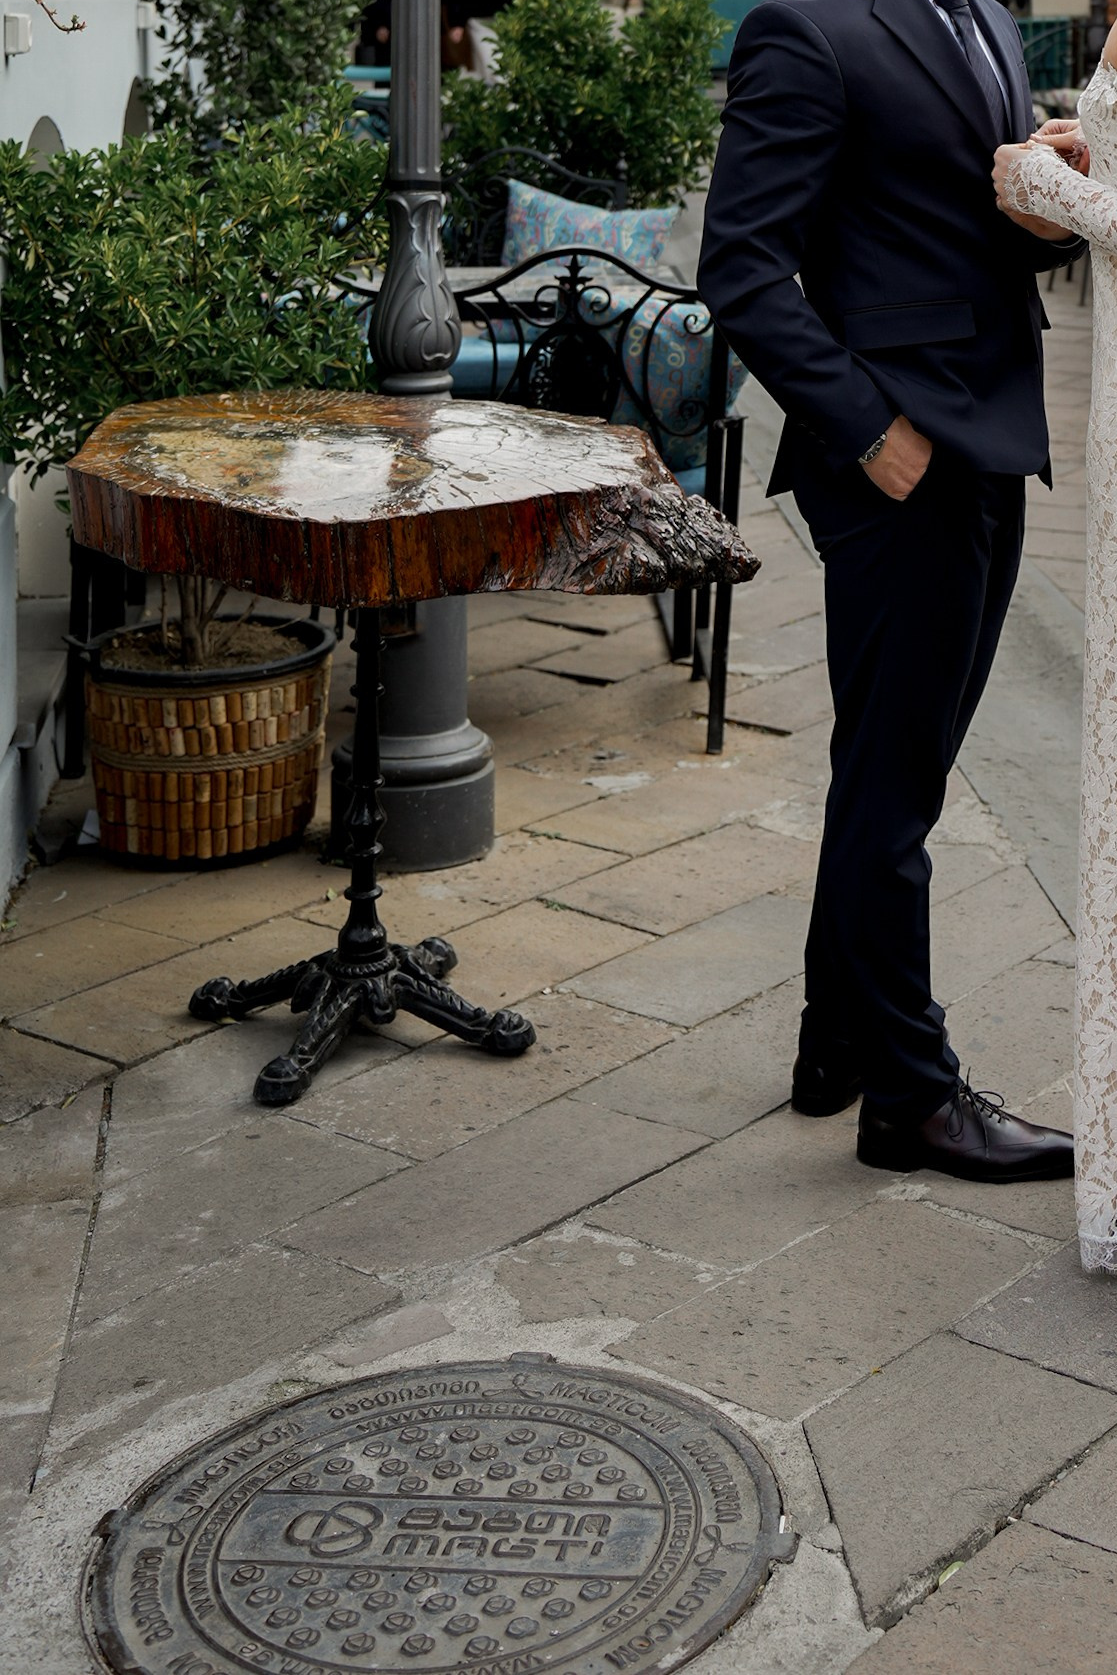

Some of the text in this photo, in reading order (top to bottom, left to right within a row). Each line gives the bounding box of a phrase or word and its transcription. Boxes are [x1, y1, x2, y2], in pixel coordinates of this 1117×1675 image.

[550, 1380, 681, 1435] MAGTICOM
[382, 1533, 606, 1562] MAGTI
[604, 1567, 728, 1670] MAGTICOM
